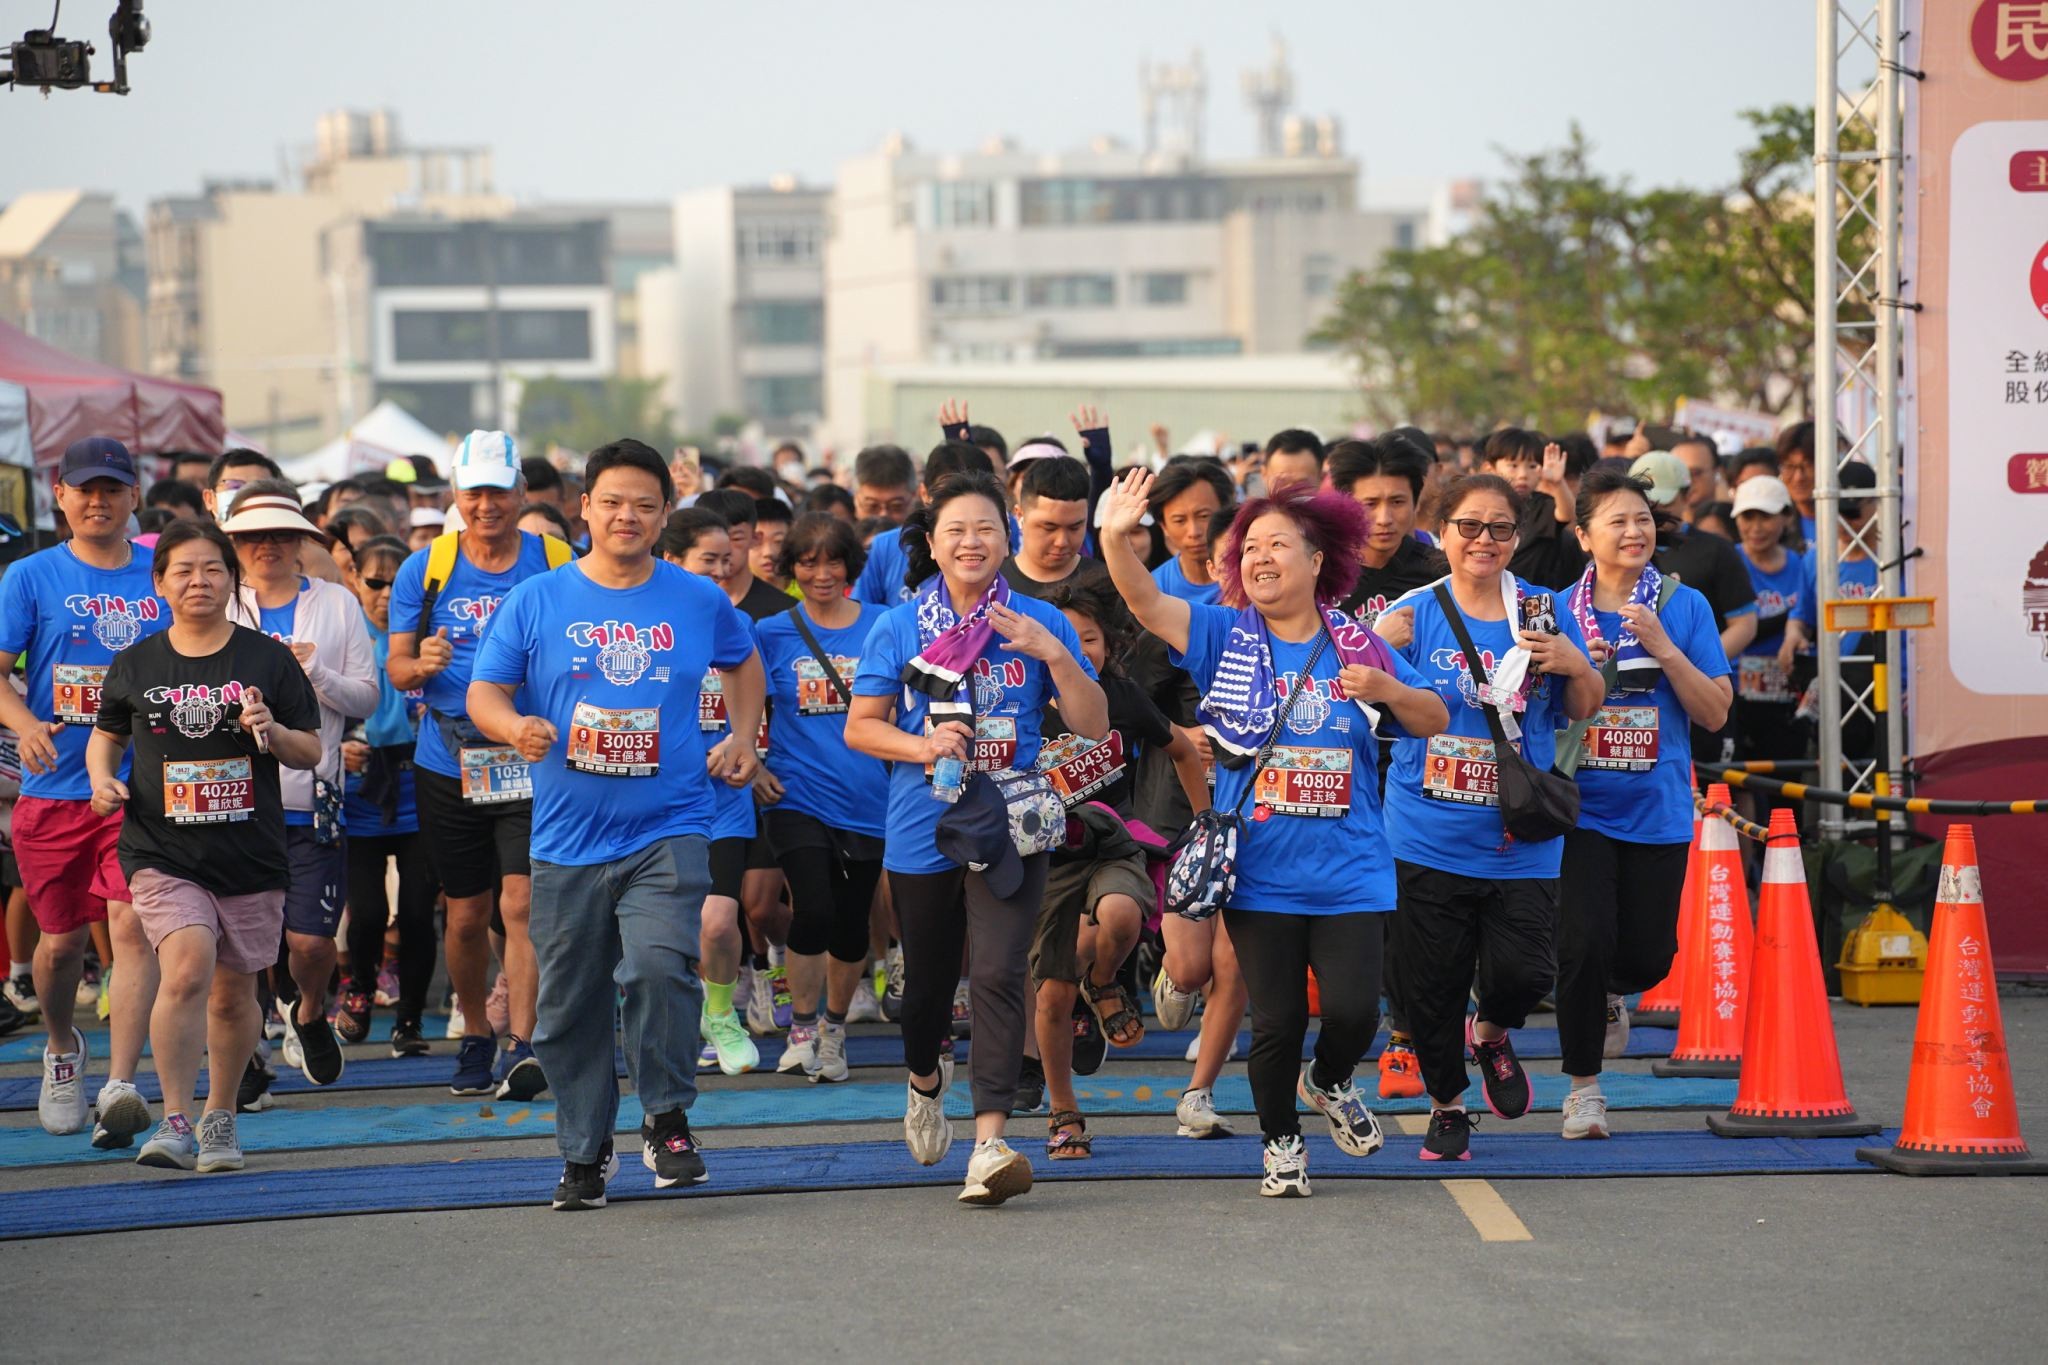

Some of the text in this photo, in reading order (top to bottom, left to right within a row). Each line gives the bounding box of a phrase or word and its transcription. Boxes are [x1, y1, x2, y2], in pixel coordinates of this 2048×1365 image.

[602, 733, 654, 749] 30035
[1603, 730, 1653, 745] 40800
[1065, 744, 1113, 778] 30435
[200, 781, 248, 798] 40222
[1292, 773, 1345, 790] 40802
[1299, 790, 1338, 803] 呂玉玲
[1709, 863, 1739, 1020] 台灣運動賽事協會
